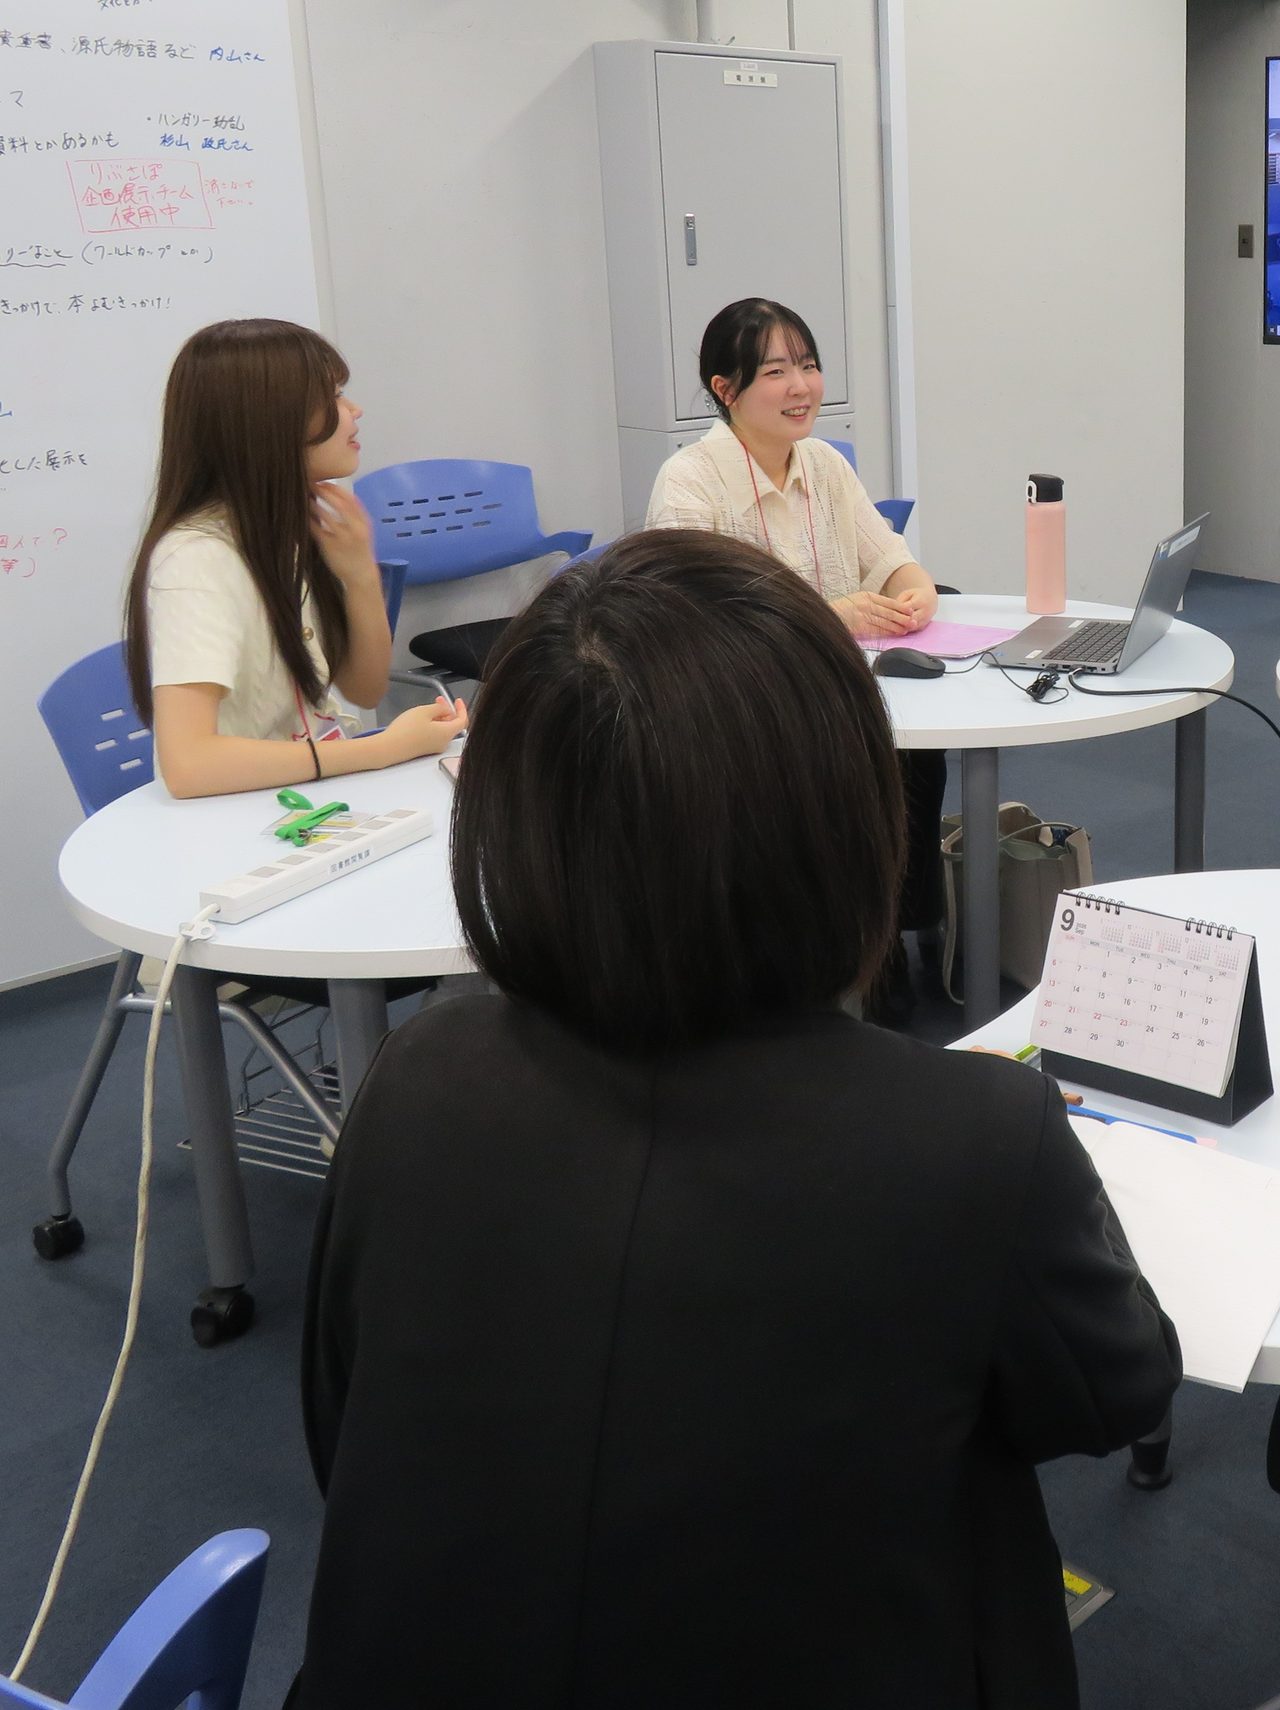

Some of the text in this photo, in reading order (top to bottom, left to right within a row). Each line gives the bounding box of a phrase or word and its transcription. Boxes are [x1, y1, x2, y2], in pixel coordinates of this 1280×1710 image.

[110, 203, 180, 228] 使用中
[1060, 908, 1075, 932] 9
[1153, 984, 1162, 992] 10
[1179, 990, 1187, 998] 11
[1205, 996, 1213, 1004] 12
[1098, 992, 1106, 1000] 15
[1123, 998, 1131, 1006] 16
[1149, 1004, 1158, 1012] 17
[1175, 1010, 1184, 1019] 18
[1201, 1018, 1209, 1026] 19
[1039, 1020, 1125, 1048] 27 28 29 30
[1043, 1000, 1205, 1047] 20 21 22 23 24 25 26
